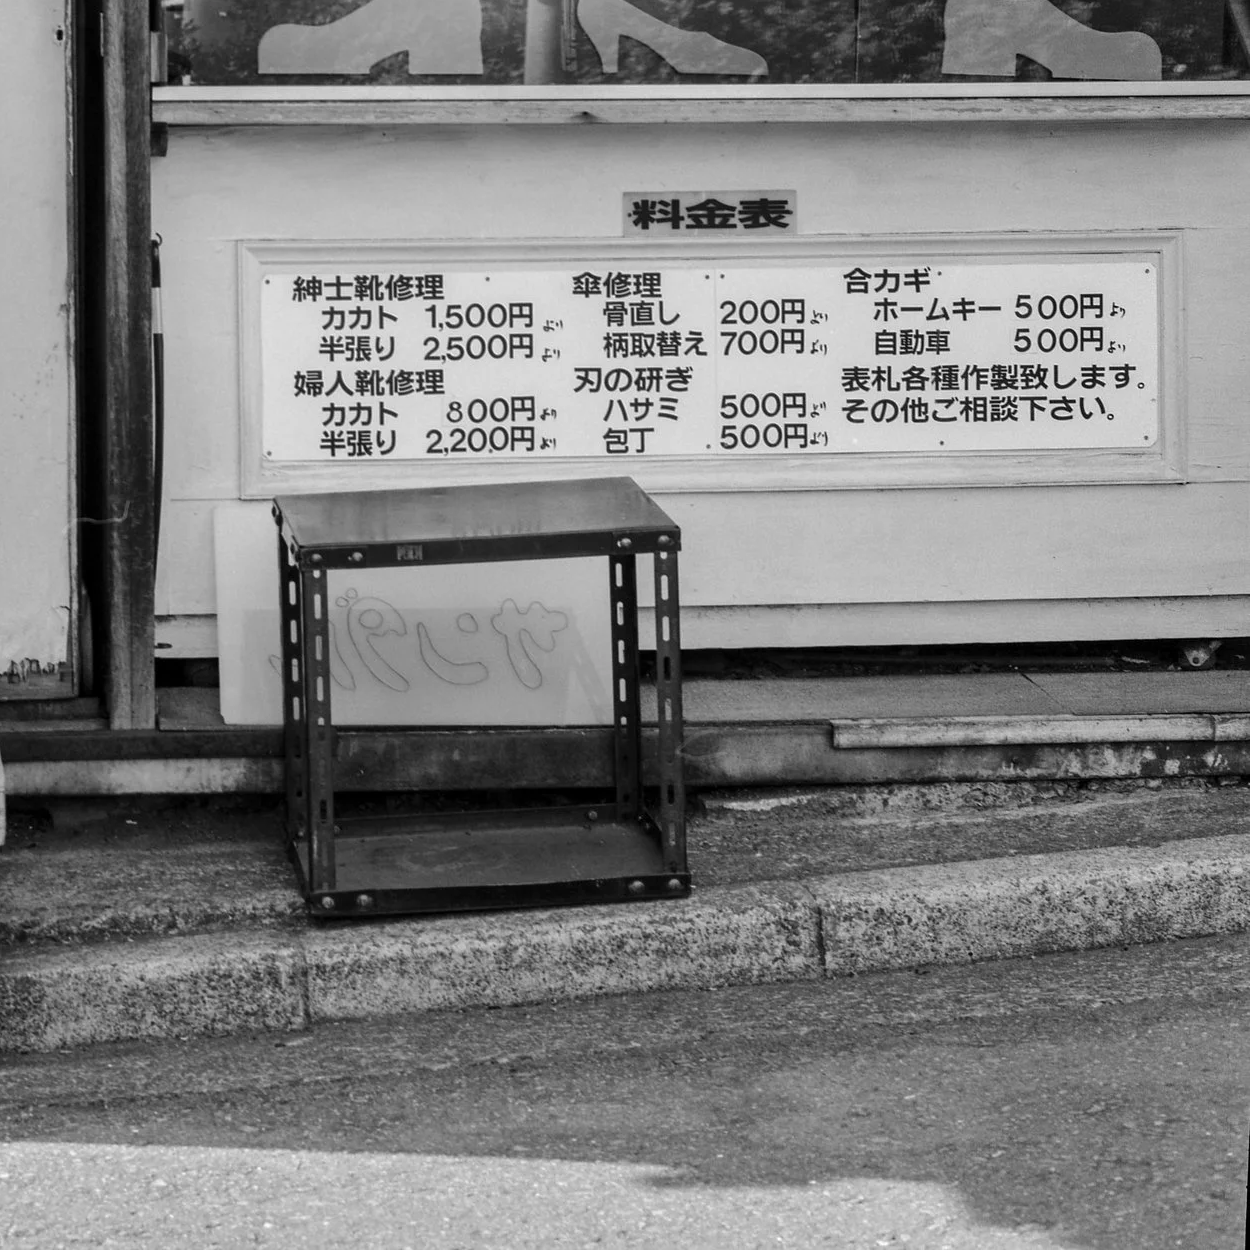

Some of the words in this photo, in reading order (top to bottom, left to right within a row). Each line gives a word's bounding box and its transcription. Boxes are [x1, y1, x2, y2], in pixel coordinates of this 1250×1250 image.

[631, 198, 793, 230] 料金表
[293, 274, 444, 302] 紳士靴修理
[571, 272, 662, 299] 傘修理
[843, 266, 931, 294] 合カギ
[322, 306, 398, 331] カカト
[425, 303, 533, 332] 1,500円
[603, 301, 680, 327] 骨直し
[719, 298, 806, 325] 200円
[873, 296, 1002, 323] ホームキー
[1014, 293, 1104, 320] 500円
[319, 336, 395, 362] 半張り
[423, 334, 533, 363] 2,500円
[603, 331, 708, 359] 柄取替え
[720, 328, 805, 356] 700円
[874, 329, 950, 355] 自動車
[1013, 327, 1104, 353] 500円
[294, 370, 444, 397] 婦人靴修理
[572, 366, 693, 394] 刃の研ぎ
[841, 364, 1145, 392] 表札各種作製致します。
[322, 402, 398, 426] カカト
[447, 396, 535, 423] 800円
[603, 398, 680, 422] ハサミ
[720, 392, 807, 419] 500円
[841, 395, 1115, 424] その他ご相談下さい。
[320, 430, 396, 456] 半張り
[426, 427, 535, 456] 2,200円
[603, 427, 655, 453] 包丁
[720, 423, 808, 450] 500円
